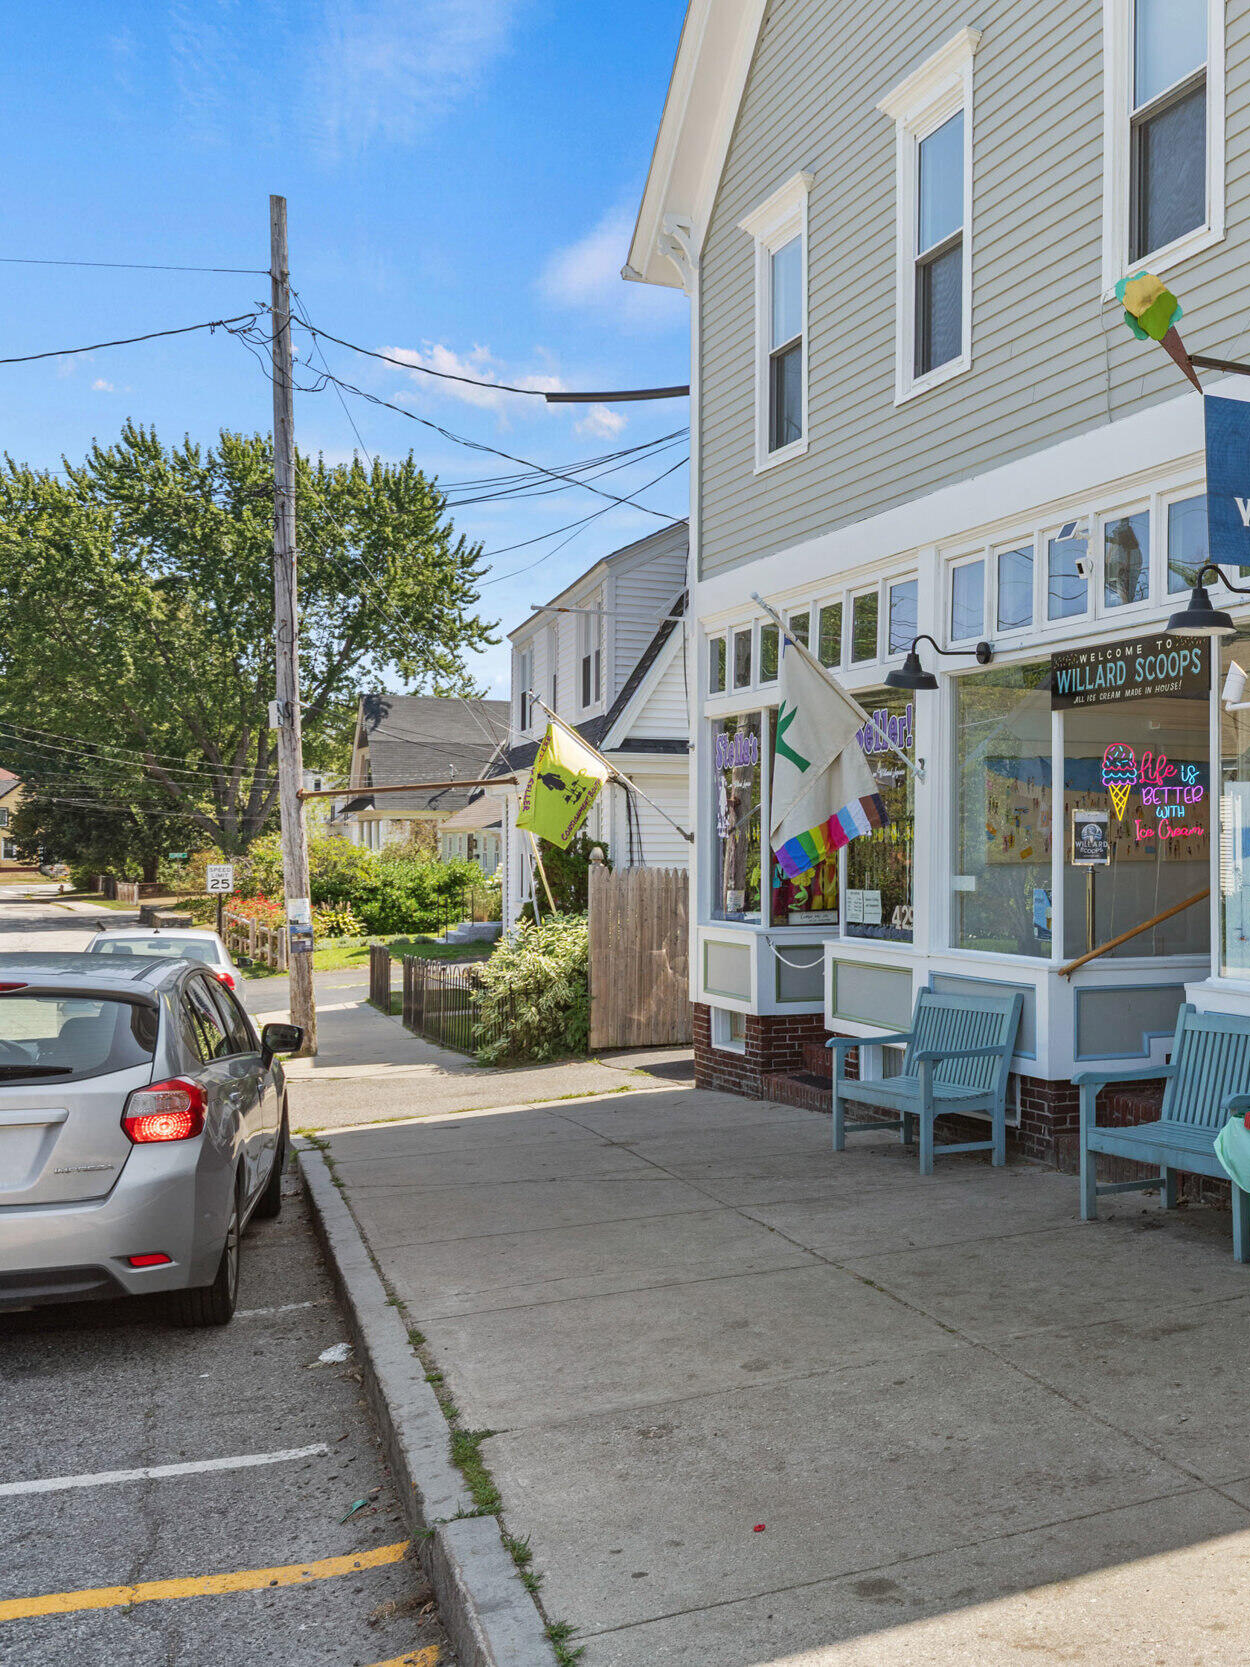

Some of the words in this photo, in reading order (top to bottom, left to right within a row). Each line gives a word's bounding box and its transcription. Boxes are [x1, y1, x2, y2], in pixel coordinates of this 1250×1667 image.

[1079, 644, 1143, 664] WELCOME
[1156, 638, 1173, 651] TO
[1056, 660, 1127, 694] WILLARD
[1134, 647, 1202, 682] SCOOPS
[1073, 695, 1085, 704] ALL
[1086, 693, 1096, 702] ICE
[1099, 690, 1121, 702] CREAM
[1124, 687, 1142, 698] MADE
[1144, 686, 1152, 695] IN
[1155, 679, 1183, 693] HOUSE!
[716, 732, 758, 770] Stella's
[1180, 764, 1200, 785] is
[1141, 785, 1204, 806] BETTER
[1155, 804, 1186, 819] WITH
[1134, 818, 1155, 841] Ice
[1158, 818, 1205, 840] Cream
[1075, 840, 1109, 848] WILLARD
[210, 878, 230, 890] 25
